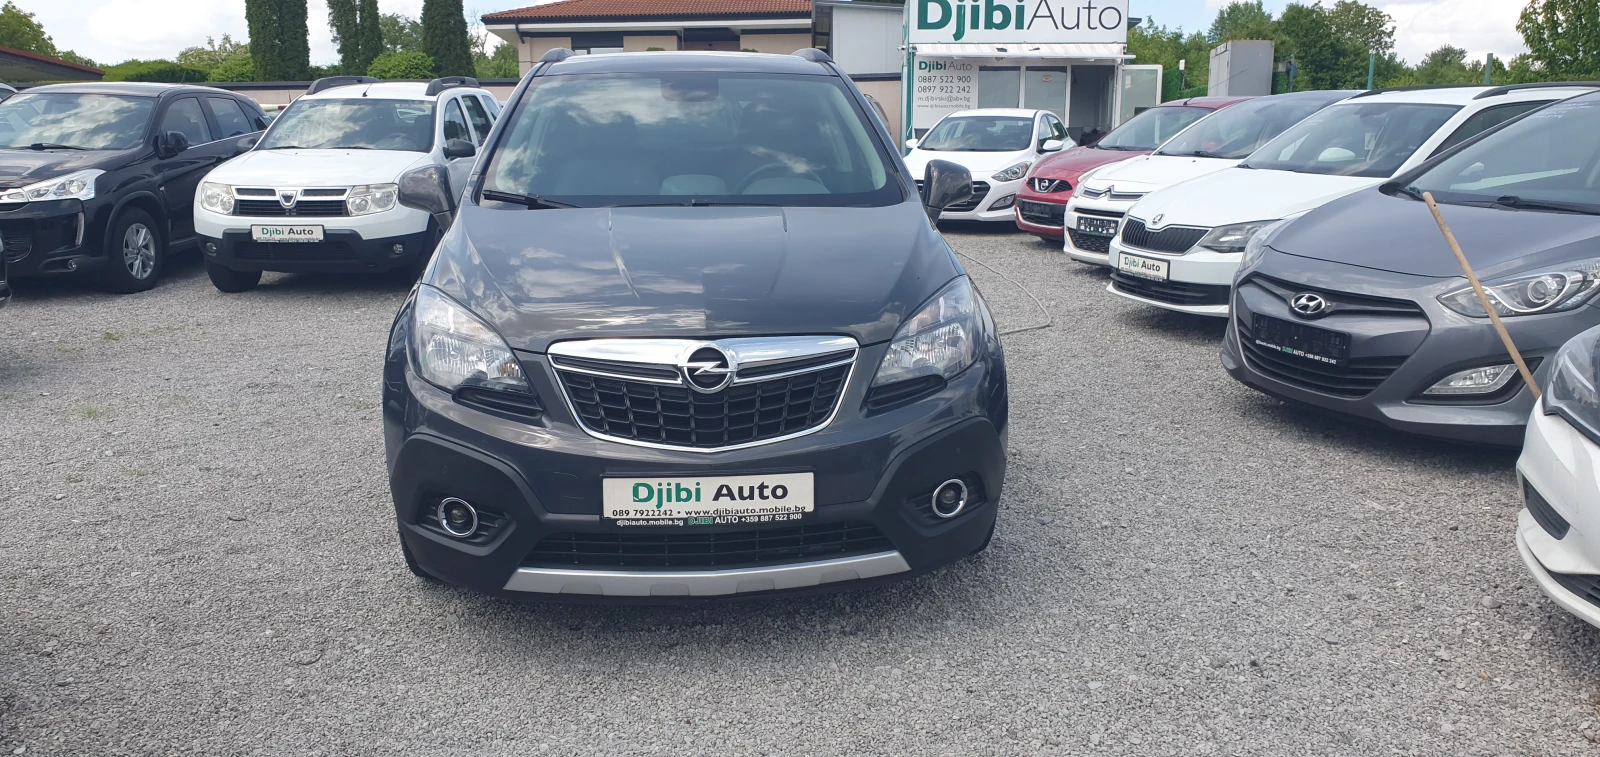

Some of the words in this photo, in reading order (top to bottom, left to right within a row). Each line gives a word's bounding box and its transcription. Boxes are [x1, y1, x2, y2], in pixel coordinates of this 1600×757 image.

[918, 75, 937, 84] 0887
[939, 75, 954, 84] 522
[956, 75, 972, 84] 900
[917, 85, 937, 94] 0897
[939, 85, 954, 94] 922
[956, 85, 971, 94] 242
[261, 227, 284, 237] Djibi
[287, 227, 313, 235] Auto
[1124, 256, 1140, 269] Djibi
[1141, 260, 1161, 272] Auto
[1293, 349, 1305, 357] AUTO
[632, 482, 701, 511] Djibi
[712, 480, 789, 502] Auto
[612, 509, 631, 517] 089
[633, 509, 674, 517] 7922242
[685, 505, 805, 517] www.djibiauto.mobile.bg
[617, 519, 683, 527] djibiauto.mobile.bg
[687, 516, 714, 525] DJIBI
[714, 515, 739, 524] AUTO
[741, 515, 759, 523] +359
